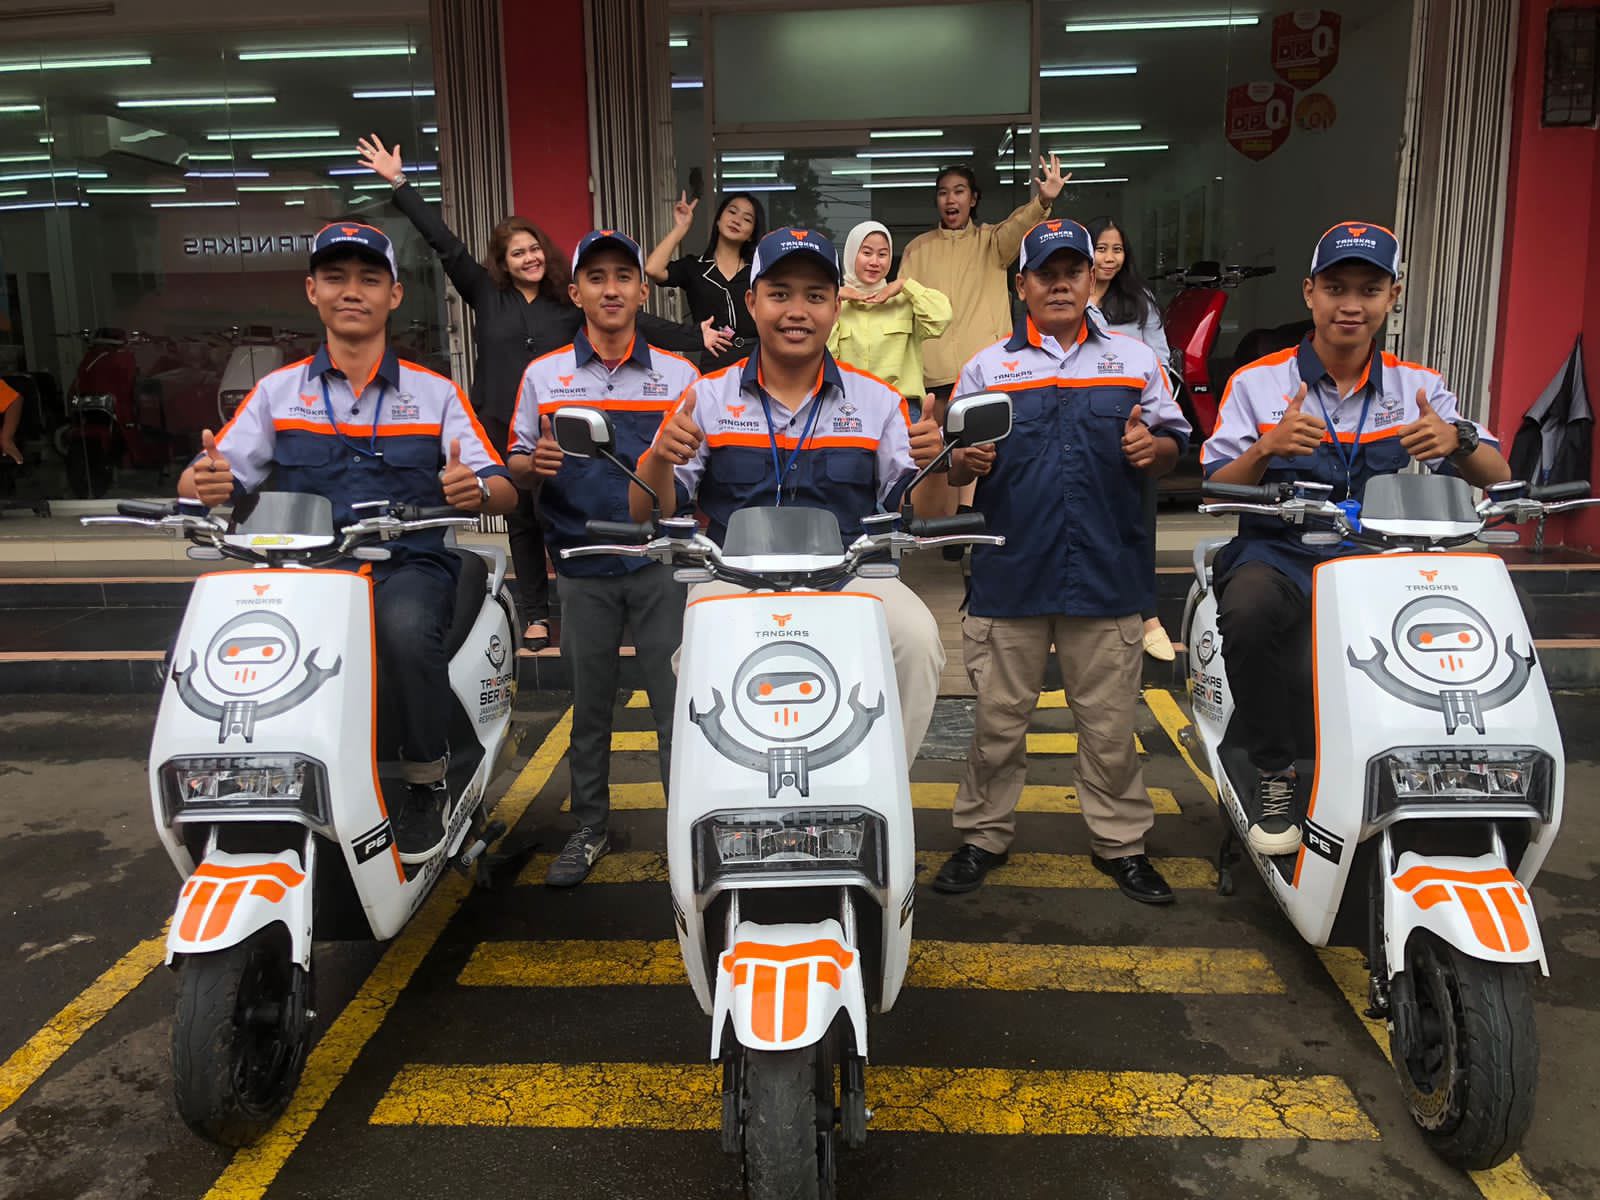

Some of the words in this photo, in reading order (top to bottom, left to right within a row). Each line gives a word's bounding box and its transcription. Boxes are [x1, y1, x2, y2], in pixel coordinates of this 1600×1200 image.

[780, 240, 820, 250] TANGKAS
[1335, 238, 1376, 246] TANGKAS
[993, 370, 1033, 382] TANGKAS
[718, 418, 760, 428] TANGKAS
[235, 598, 283, 606] TANGKAS
[755, 630, 809, 638] TANGKAS
[365, 833, 387, 855] P6
[1309, 832, 1332, 855] P6
